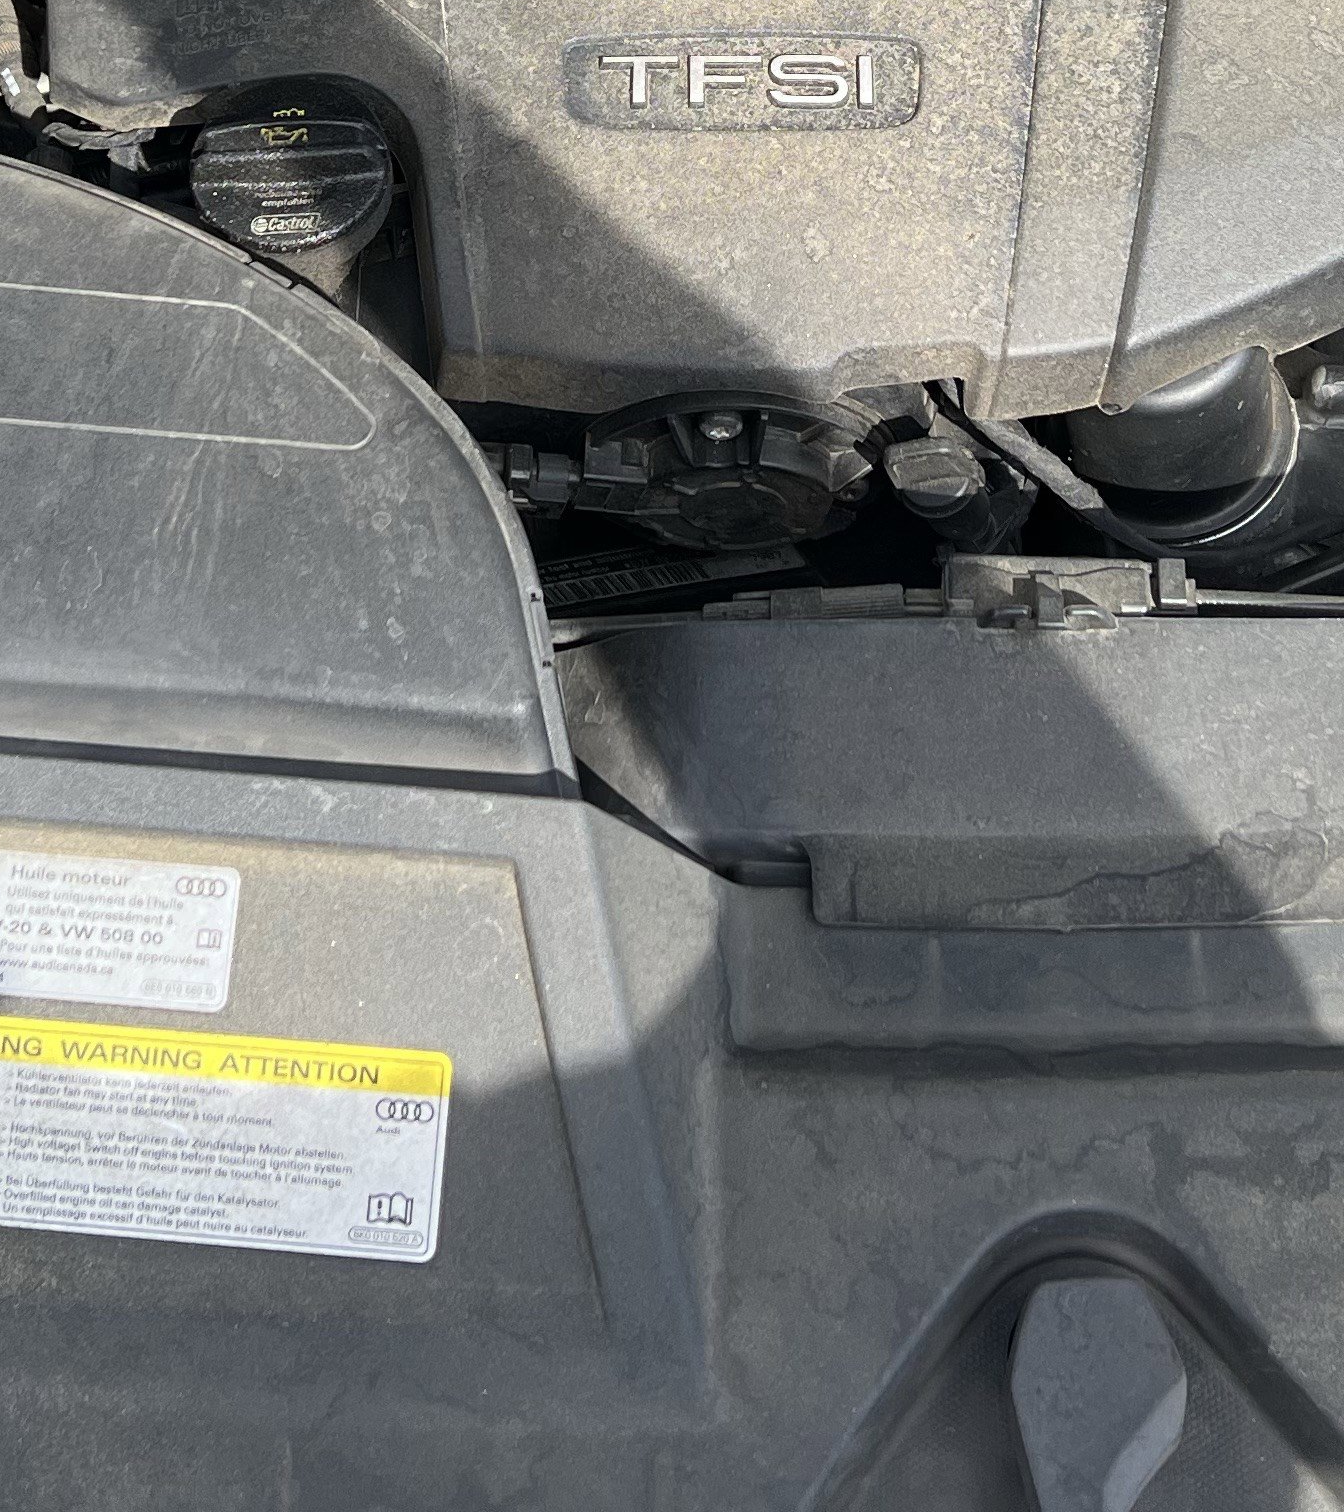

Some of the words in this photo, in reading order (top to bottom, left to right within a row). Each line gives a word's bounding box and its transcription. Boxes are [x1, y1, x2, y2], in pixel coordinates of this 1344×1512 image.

[599, 53, 875, 109] TFSI
[267, 215, 316, 231] Castrol
[10, 865, 56, 882] Huile
[62, 871, 130, 888] moteur
[4, 902, 25, 916] qui
[6, 886, 51, 901] Utilisez
[53, 889, 124, 909] uniquement
[128, 895, 143, 908] de
[37, 922, 52, 937] &
[58, 923, 95, 940] VW
[99, 927, 135, 943] 508
[139, 930, 164, 946] 00
[0, 939, 27, 953] Pour
[30, 944, 52, 955] une
[56, 944, 81, 957] liste
[60, 1039, 202, 1070] WARNING
[219, 1052, 379, 1084] ATTENTION
[63, 1087, 81, 1097] fan
[83, 1089, 105, 1100] may
[109, 1090, 132, 1101] start
[135, 1092, 147, 1102] at
[149, 1095, 168, 1106] any
[13, 1096, 25, 1107] Le
[88, 1103, 113, 1115] peut
[201, 1111, 223, 1123] tout
[376, 1125, 400, 1134] Audi
[8, 1135, 33, 1149] High
[83, 1141, 120, 1155] Switch
[122, 1144, 138, 1156] off
[140, 1147, 179, 1161] engine
[180, 1150, 215, 1164] before
[217, 1153, 266, 1169] touching
[269, 1158, 310, 1173] ignition
[171, 1136, 188, 1147] der
[258, 1143, 290, 1155] Motor
[7, 1150, 38, 1162] Haute
[126, 1159, 136, 1169] le
[138, 1161, 177, 1174] moteur
[181, 1165, 210, 1176] avant
[213, 1167, 227, 1178] de
[230, 1168, 271, 1181] toucher
[5, 1175, 23, 1186] Bei
[92, 1183, 132, 1195] besteht
[193, 1191, 214, 1202] den
[3, 1188, 57, 1203] Overfilled
[58, 1194, 96, 1208] engine
[98, 1197, 112, 1207] oil
[115, 1200, 133, 1209] can
[137, 1200, 181, 1215] damage
[2, 1202, 18, 1213] Un
[175, 1217, 199, 1230] peut
[203, 1220, 231, 1231] nuire
[234, 1223, 247, 1233] au
